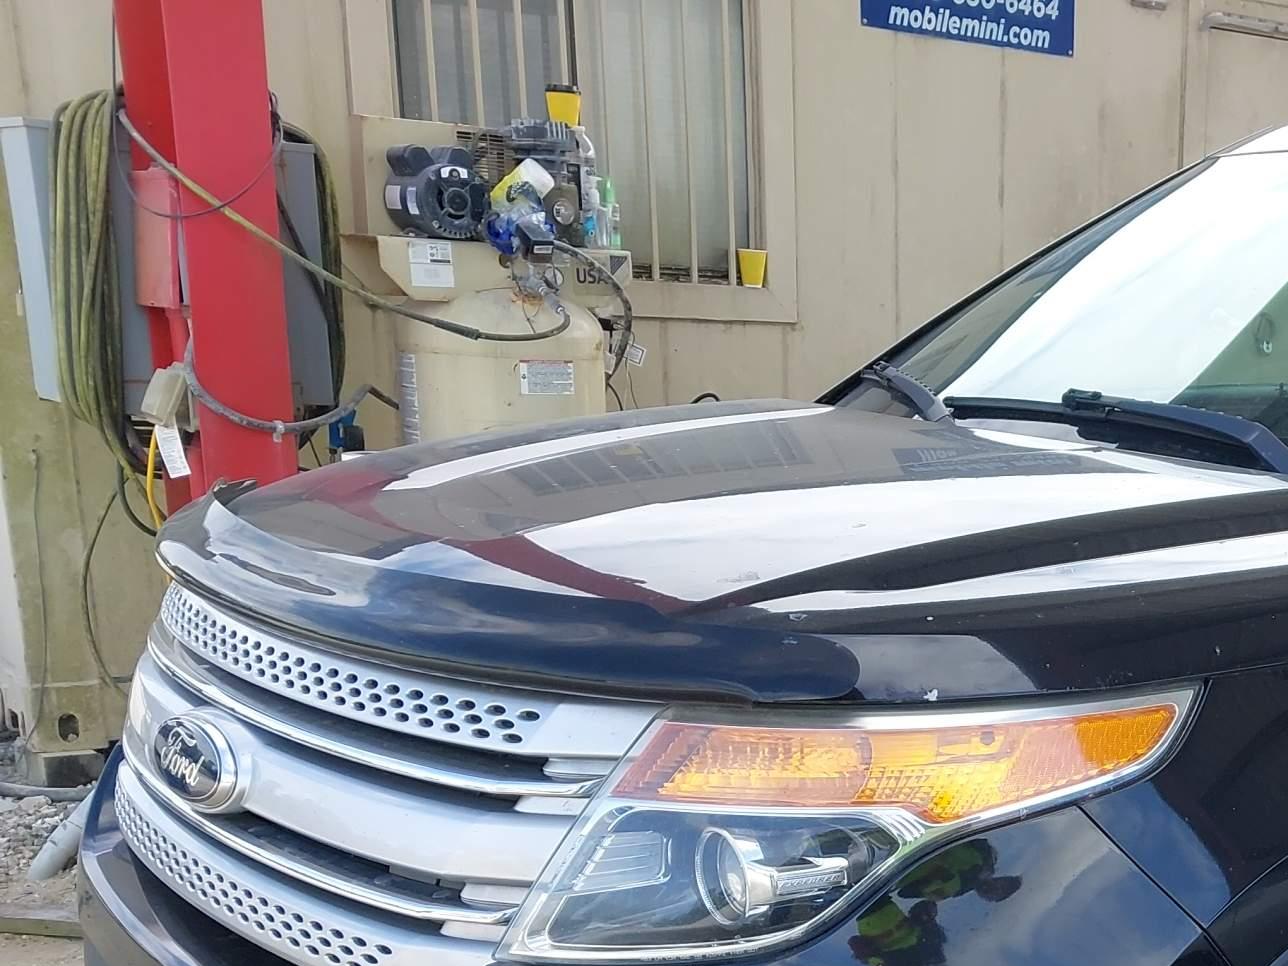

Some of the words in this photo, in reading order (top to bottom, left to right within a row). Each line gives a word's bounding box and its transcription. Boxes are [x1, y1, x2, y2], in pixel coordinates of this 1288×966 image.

[888, 5, 1051, 48] mobilemini.com
[576, 267, 609, 285] USA
[160, 726, 205, 786] Ford
